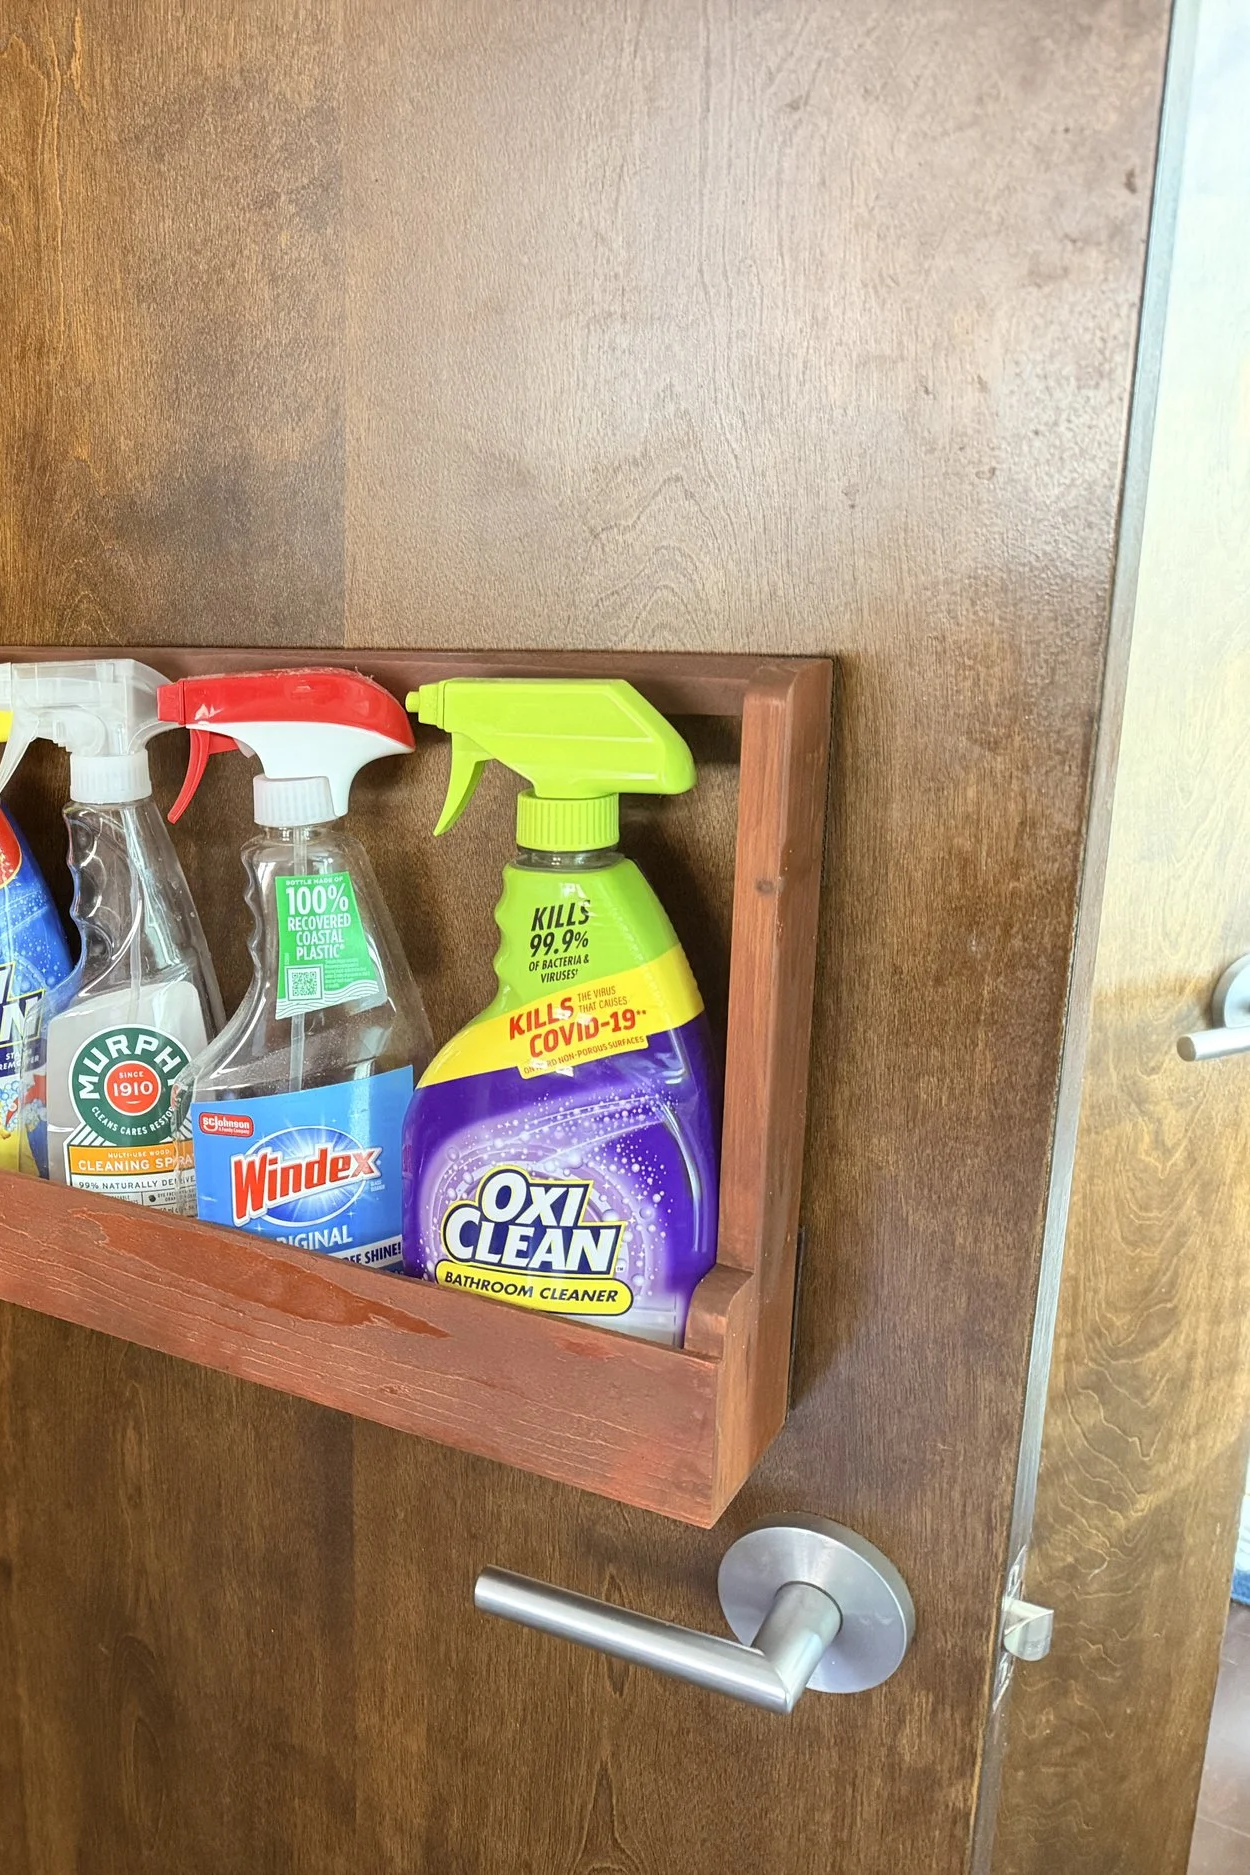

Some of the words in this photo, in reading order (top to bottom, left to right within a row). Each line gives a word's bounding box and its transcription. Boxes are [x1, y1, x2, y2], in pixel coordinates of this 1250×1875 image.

[285, 883, 349, 915] 100%
[288, 913, 351, 931] RECOVERED
[531, 900, 591, 931] KILLS
[296, 929, 344, 946] COASTAL
[530, 928, 589, 957] 99.9%
[528, 961, 540, 972] OF
[542, 956, 582, 970] BACTERIA
[582, 954, 590, 965] &
[578, 991, 591, 1002] THE
[593, 985, 616, 998] VIRUS
[578, 1001, 597, 1013] THAT
[598, 996, 628, 1009] CAUSES
[509, 997, 575, 1040] KILLS
[524, 1066, 535, 1074] ON
[558, 1044, 608, 1065] NON-POROUS
[608, 1035, 645, 1049] SURFACES
[119, 1071, 144, 1079] SINCE
[113, 1081, 154, 1097] 1910
[91, 1106, 118, 1135] CLEANS
[120, 1126, 148, 1136] CARES
[78, 1160, 150, 1172] CLEANING
[155, 1155, 194, 1169] SPRA
[108, 1150, 147, 1158] MULTI-USE
[79, 1182, 99, 1190] 99%
[102, 1180, 158, 1190] NATURALLY
[233, 1146, 377, 1220] Windex
[481, 1171, 586, 1227] OXI
[446, 1207, 617, 1272] CLEAN
[365, 1242, 402, 1264] SHINE!
[444, 1271, 534, 1298] BATHROOM
[540, 1287, 618, 1303] CLEANER
